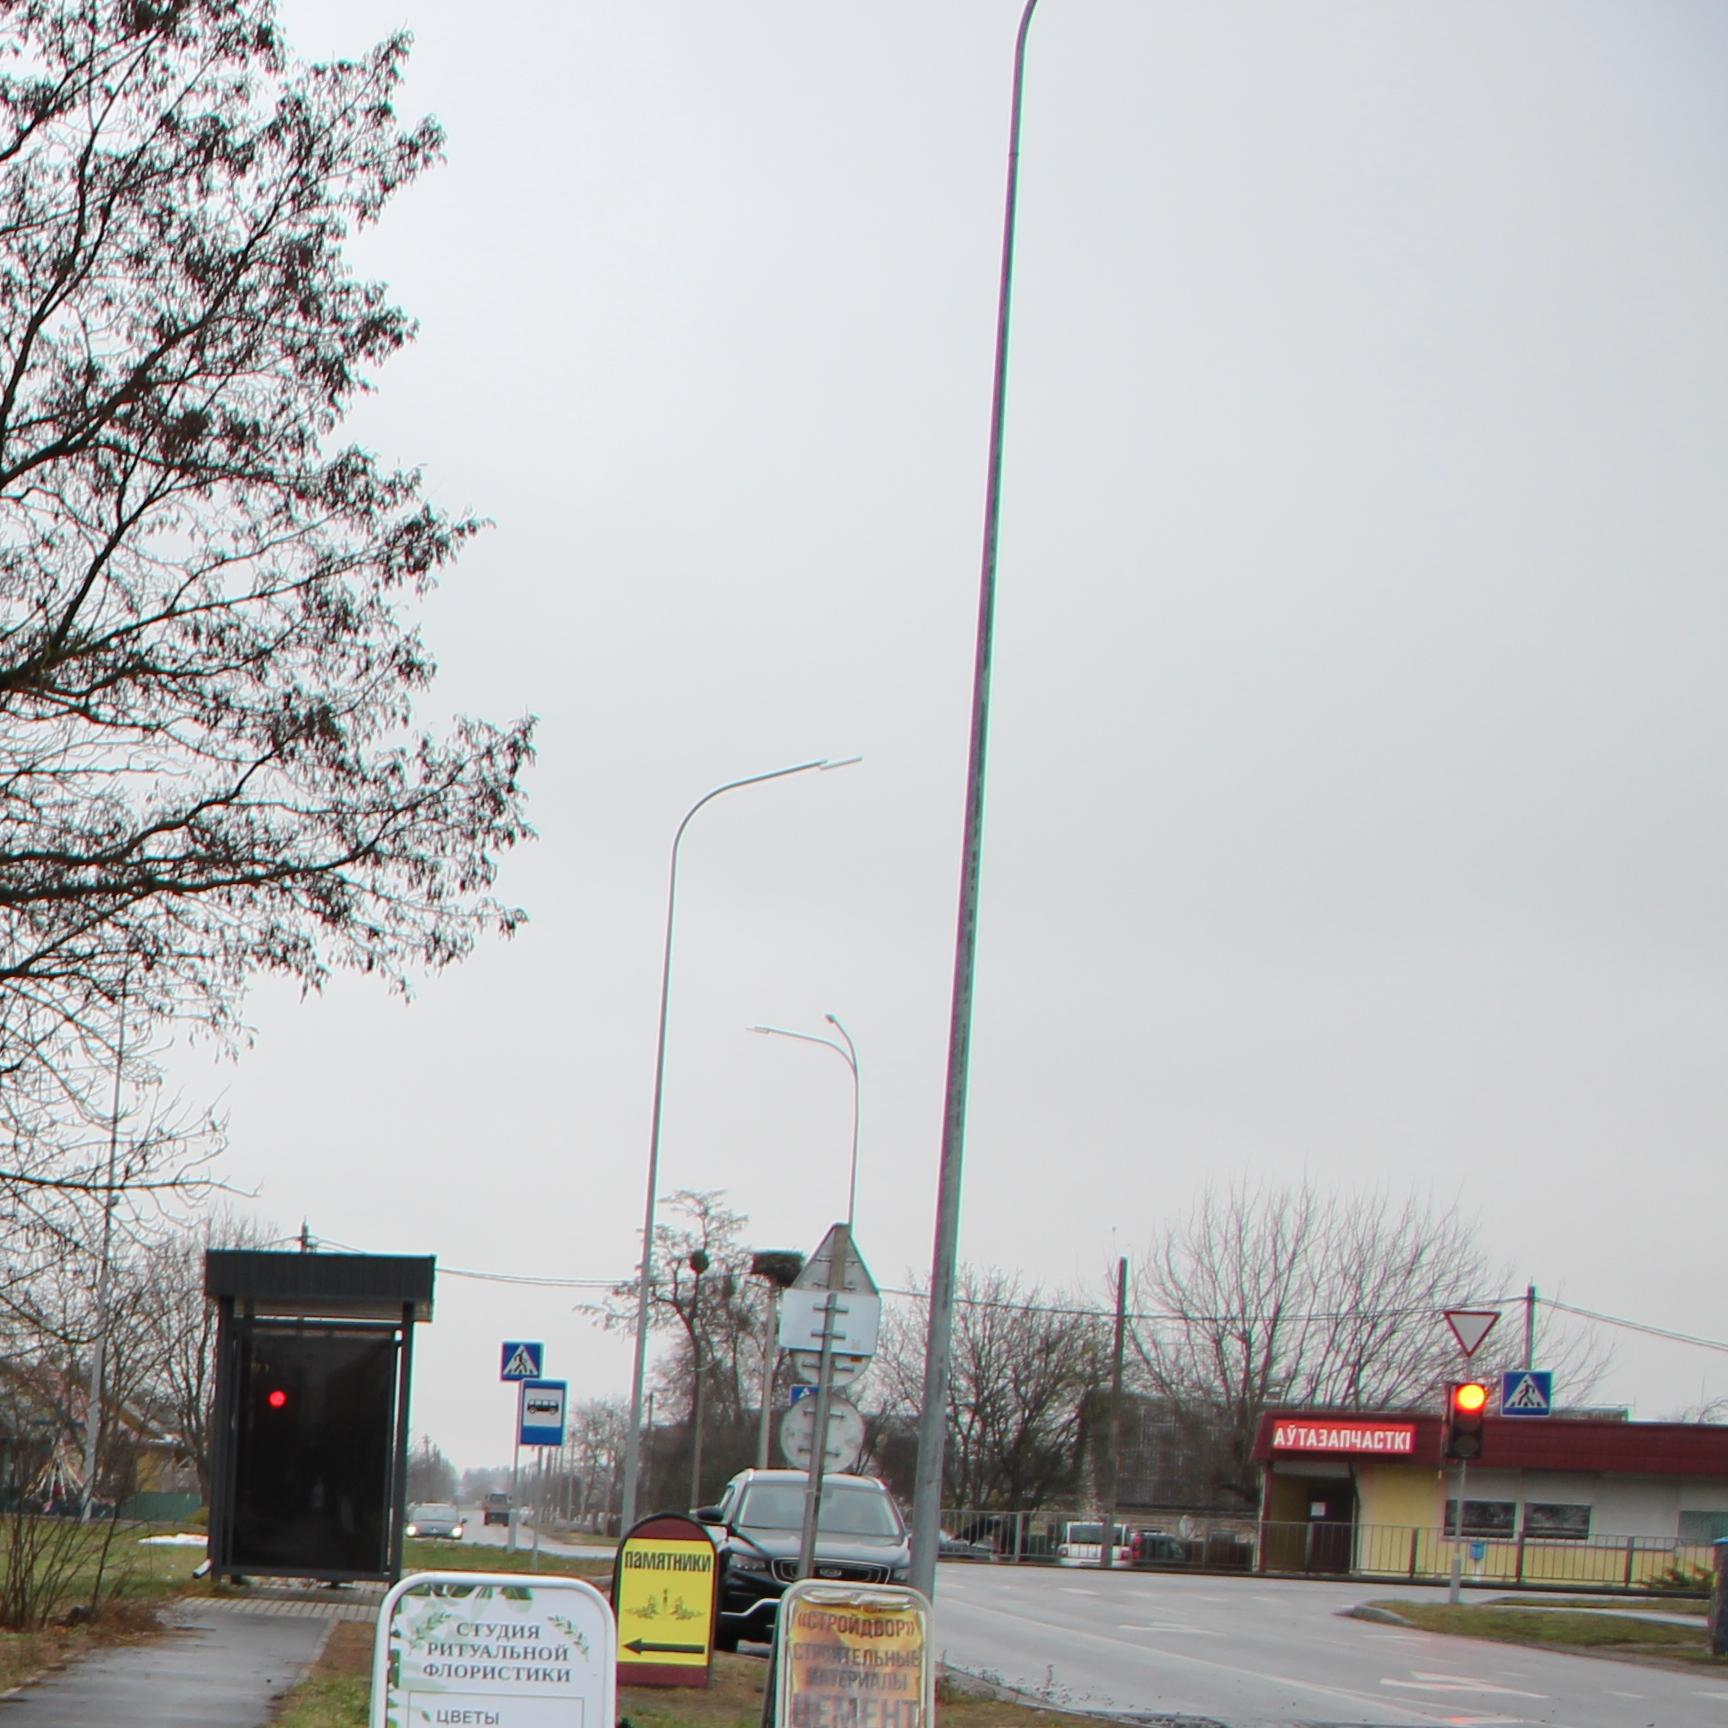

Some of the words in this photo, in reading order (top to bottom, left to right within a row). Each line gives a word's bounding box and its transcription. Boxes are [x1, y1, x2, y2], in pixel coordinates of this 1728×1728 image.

[1273, 1425, 1411, 1450] АЎТАЗАПЧАСТКІ
[456, 1621, 540, 1640] СТУДИЯ
[427, 1642, 568, 1662] РИТУАЛЬНОЙ
[423, 1663, 571, 1683] ФЛОРИСТИКИ
[436, 1709, 499, 1726] ЦВЕТЫ
